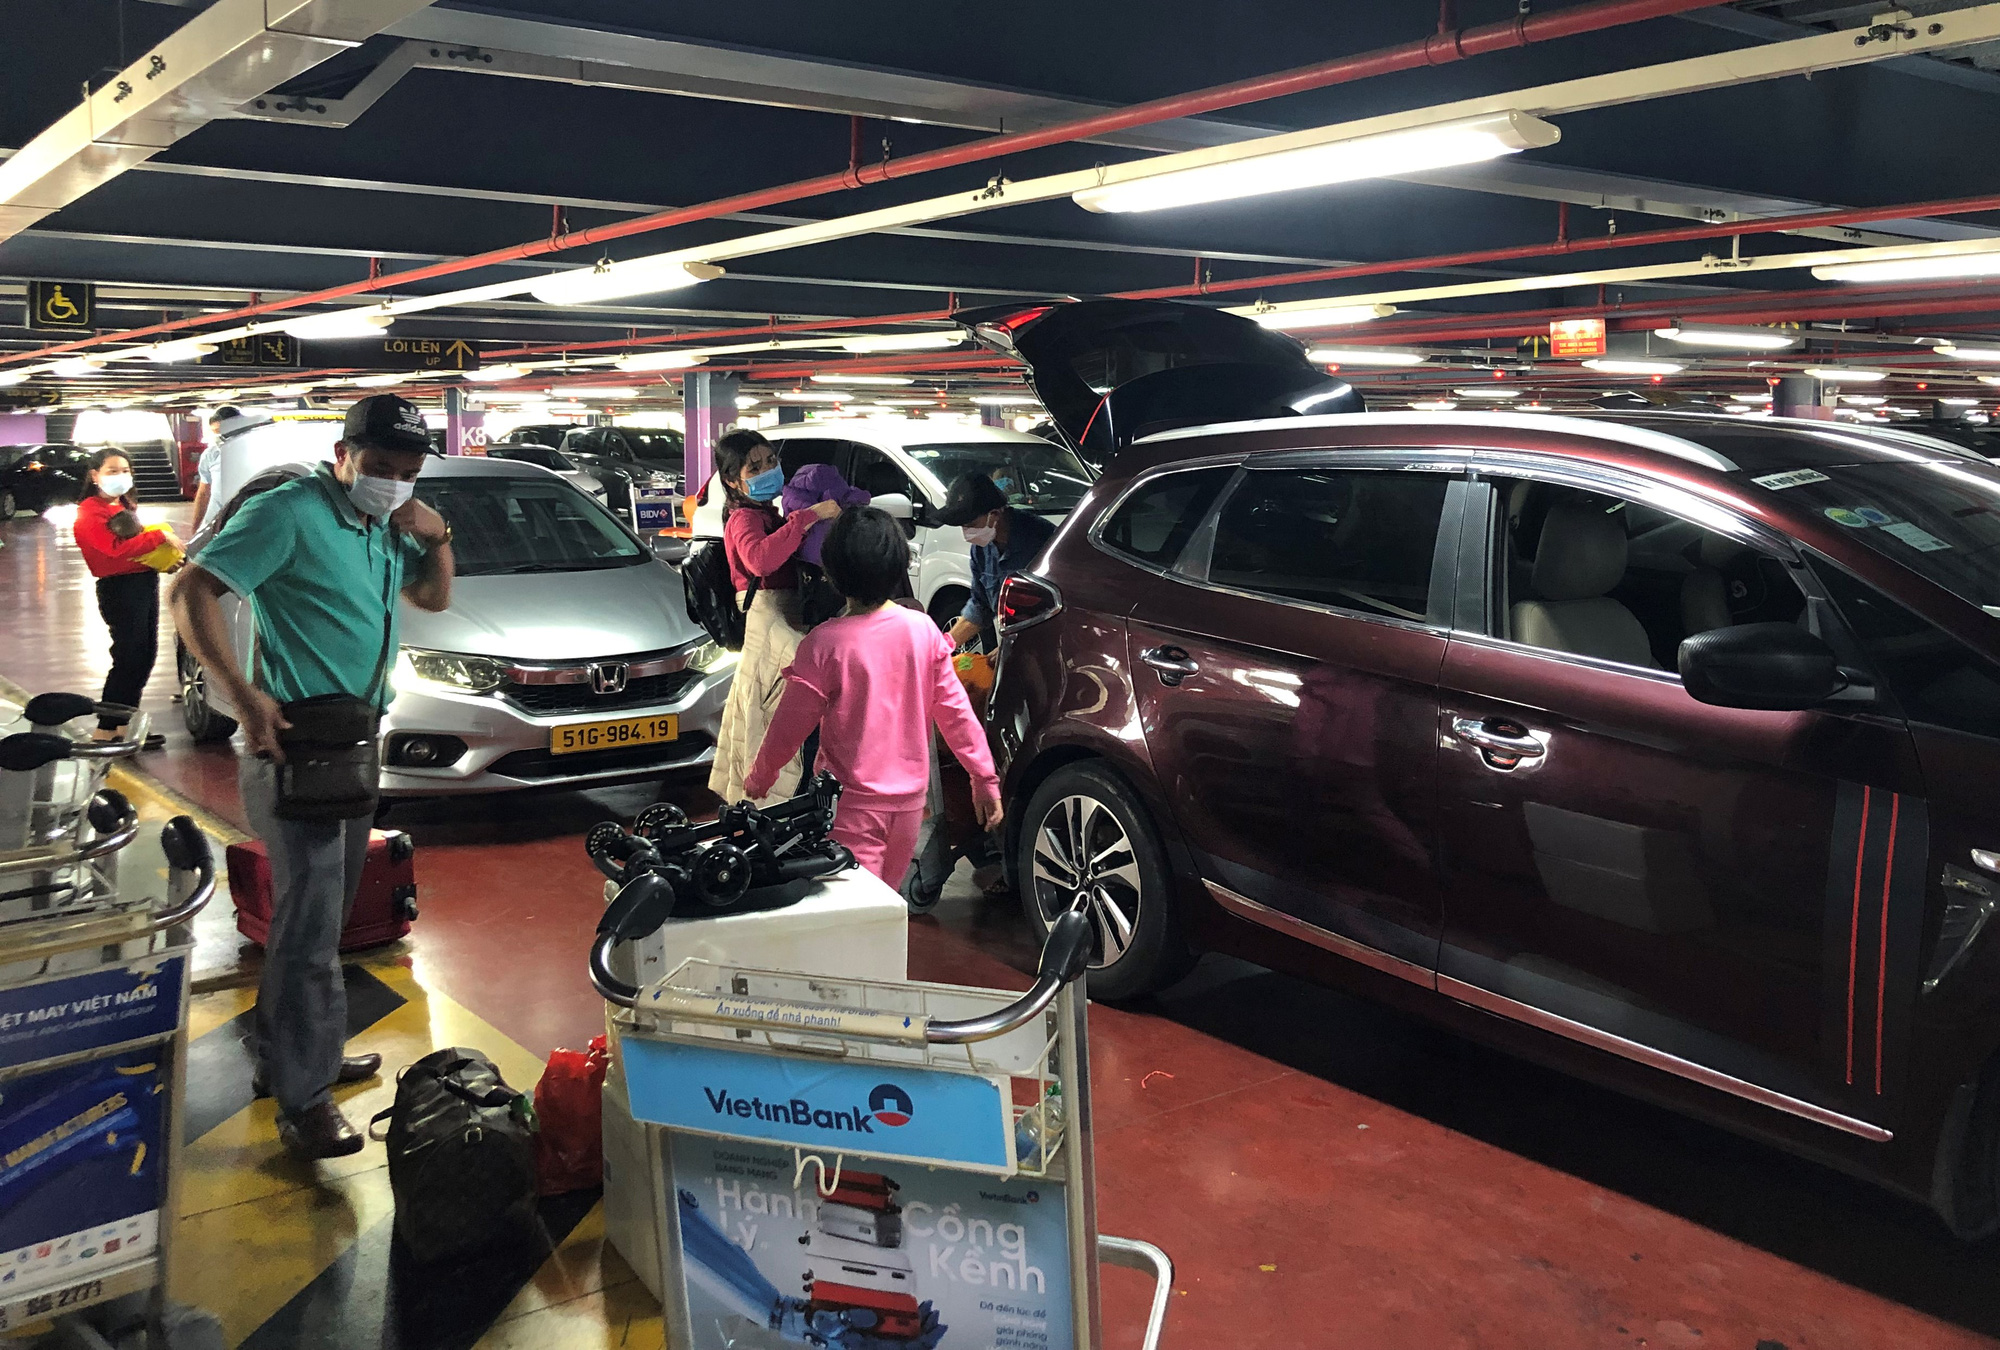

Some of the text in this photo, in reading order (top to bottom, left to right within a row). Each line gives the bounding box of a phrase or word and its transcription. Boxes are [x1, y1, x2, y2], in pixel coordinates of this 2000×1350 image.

[426, 357, 440, 366] UP
[393, 422, 425, 436] adidas
[461, 427, 486, 446] K8
[641, 509, 660, 519] BIDV
[563, 720, 669, 747] 51G-984.19
[26, 1003, 69, 1023] MAY
[72, 994, 112, 1013] VIỆT
[115, 985, 158, 1005] NAM
[804, 1014, 841, 1027] phanh!
[902, 1201, 1026, 1260] Cồng
